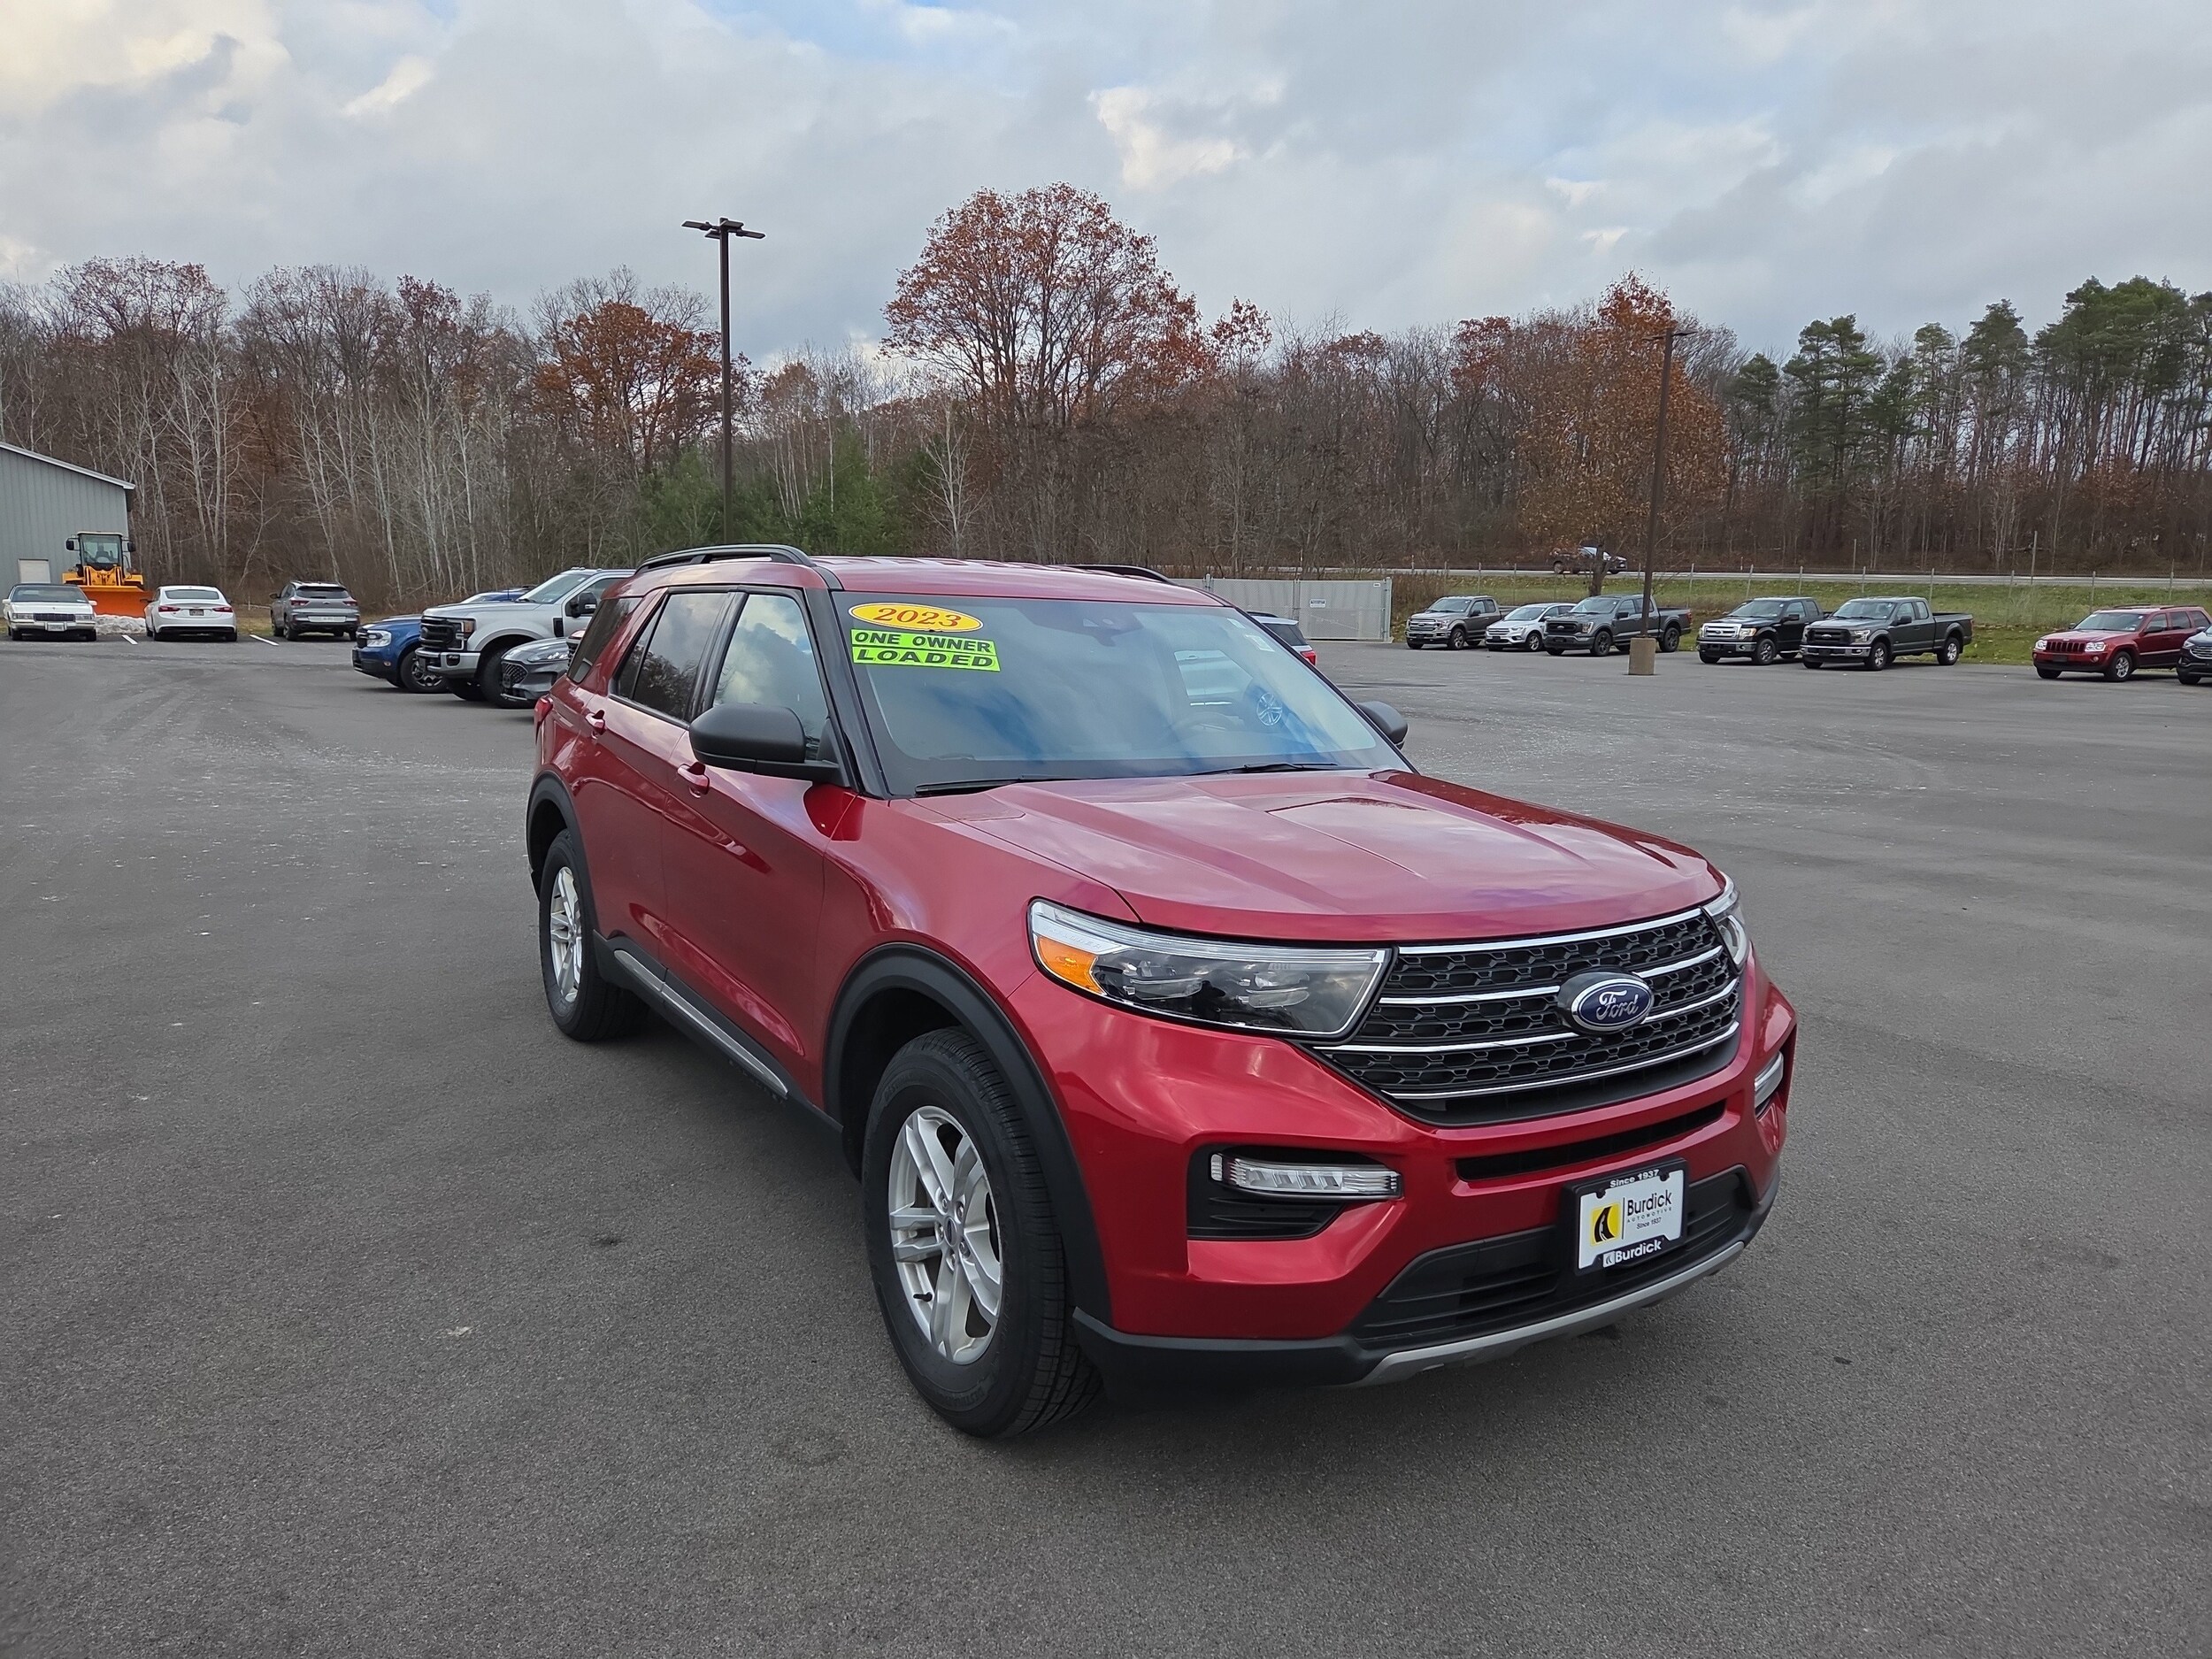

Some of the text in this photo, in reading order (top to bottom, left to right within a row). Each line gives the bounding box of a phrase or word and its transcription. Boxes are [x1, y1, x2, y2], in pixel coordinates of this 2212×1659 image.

[873, 608, 962, 627] 2023
[855, 632, 993, 654] ONE OWNER
[856, 649, 994, 668] LOADED
[1595, 989, 1640, 1021] Ford
[1609, 1169, 1660, 1188] Since 1937
[1627, 1189, 1672, 1217] Burdick
[1615, 1239, 1662, 1263] Burdick
